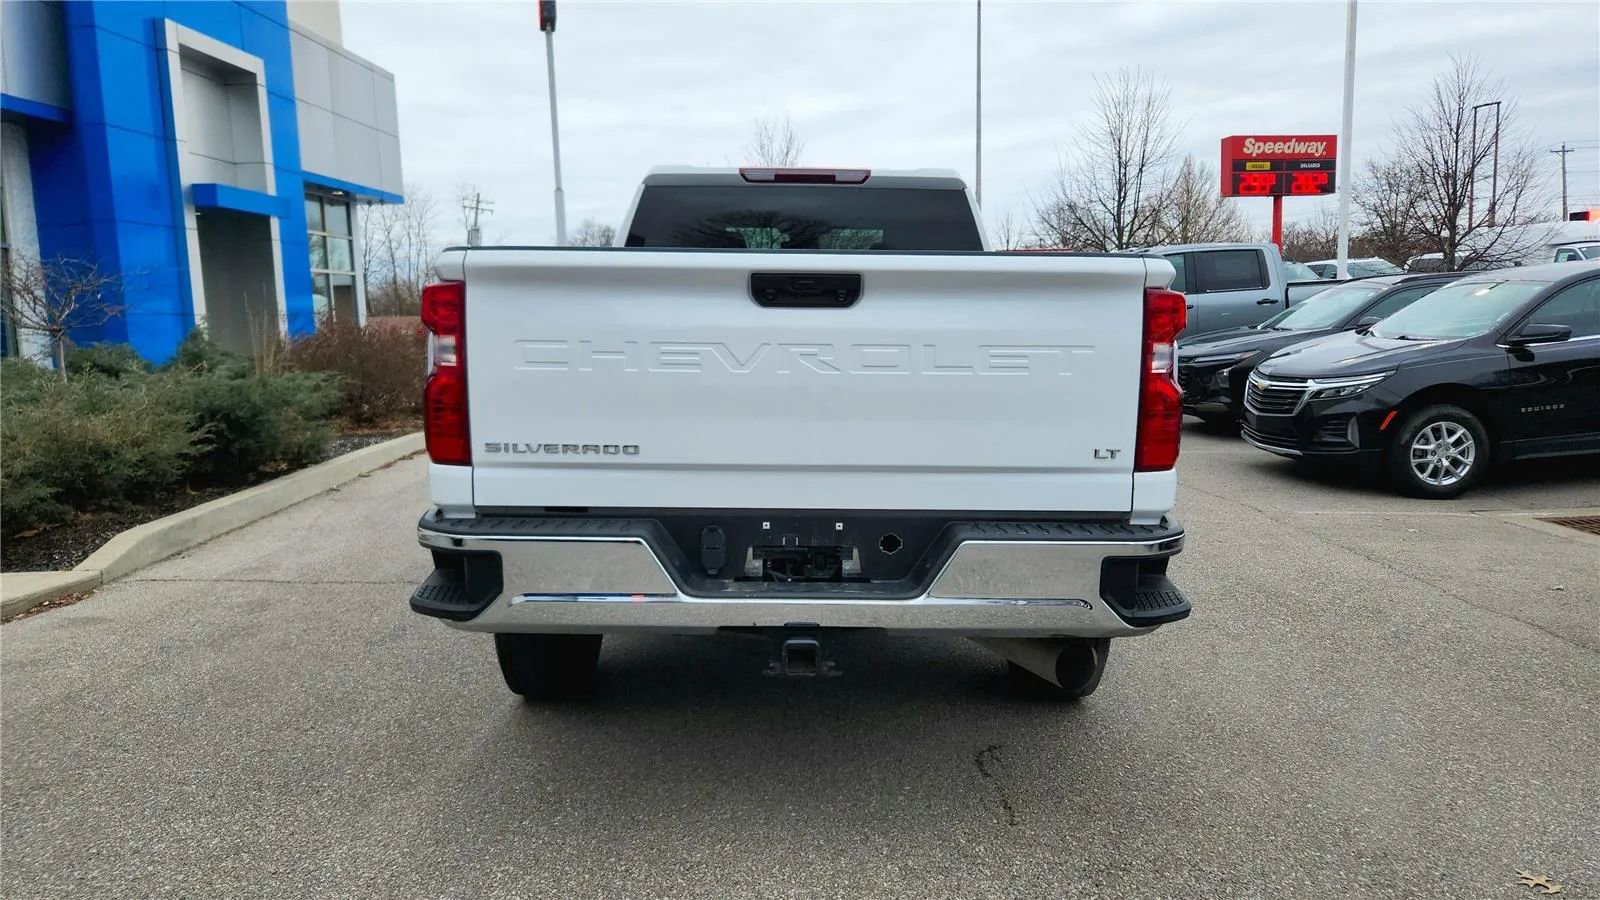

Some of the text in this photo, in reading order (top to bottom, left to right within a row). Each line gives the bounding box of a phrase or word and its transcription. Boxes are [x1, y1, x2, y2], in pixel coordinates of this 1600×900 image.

[1243, 137, 1327, 156] Speedway
[513, 339, 1096, 375] CHEVROLET
[484, 442, 640, 455] SILVERADO
[1094, 448, 1122, 460] LT
